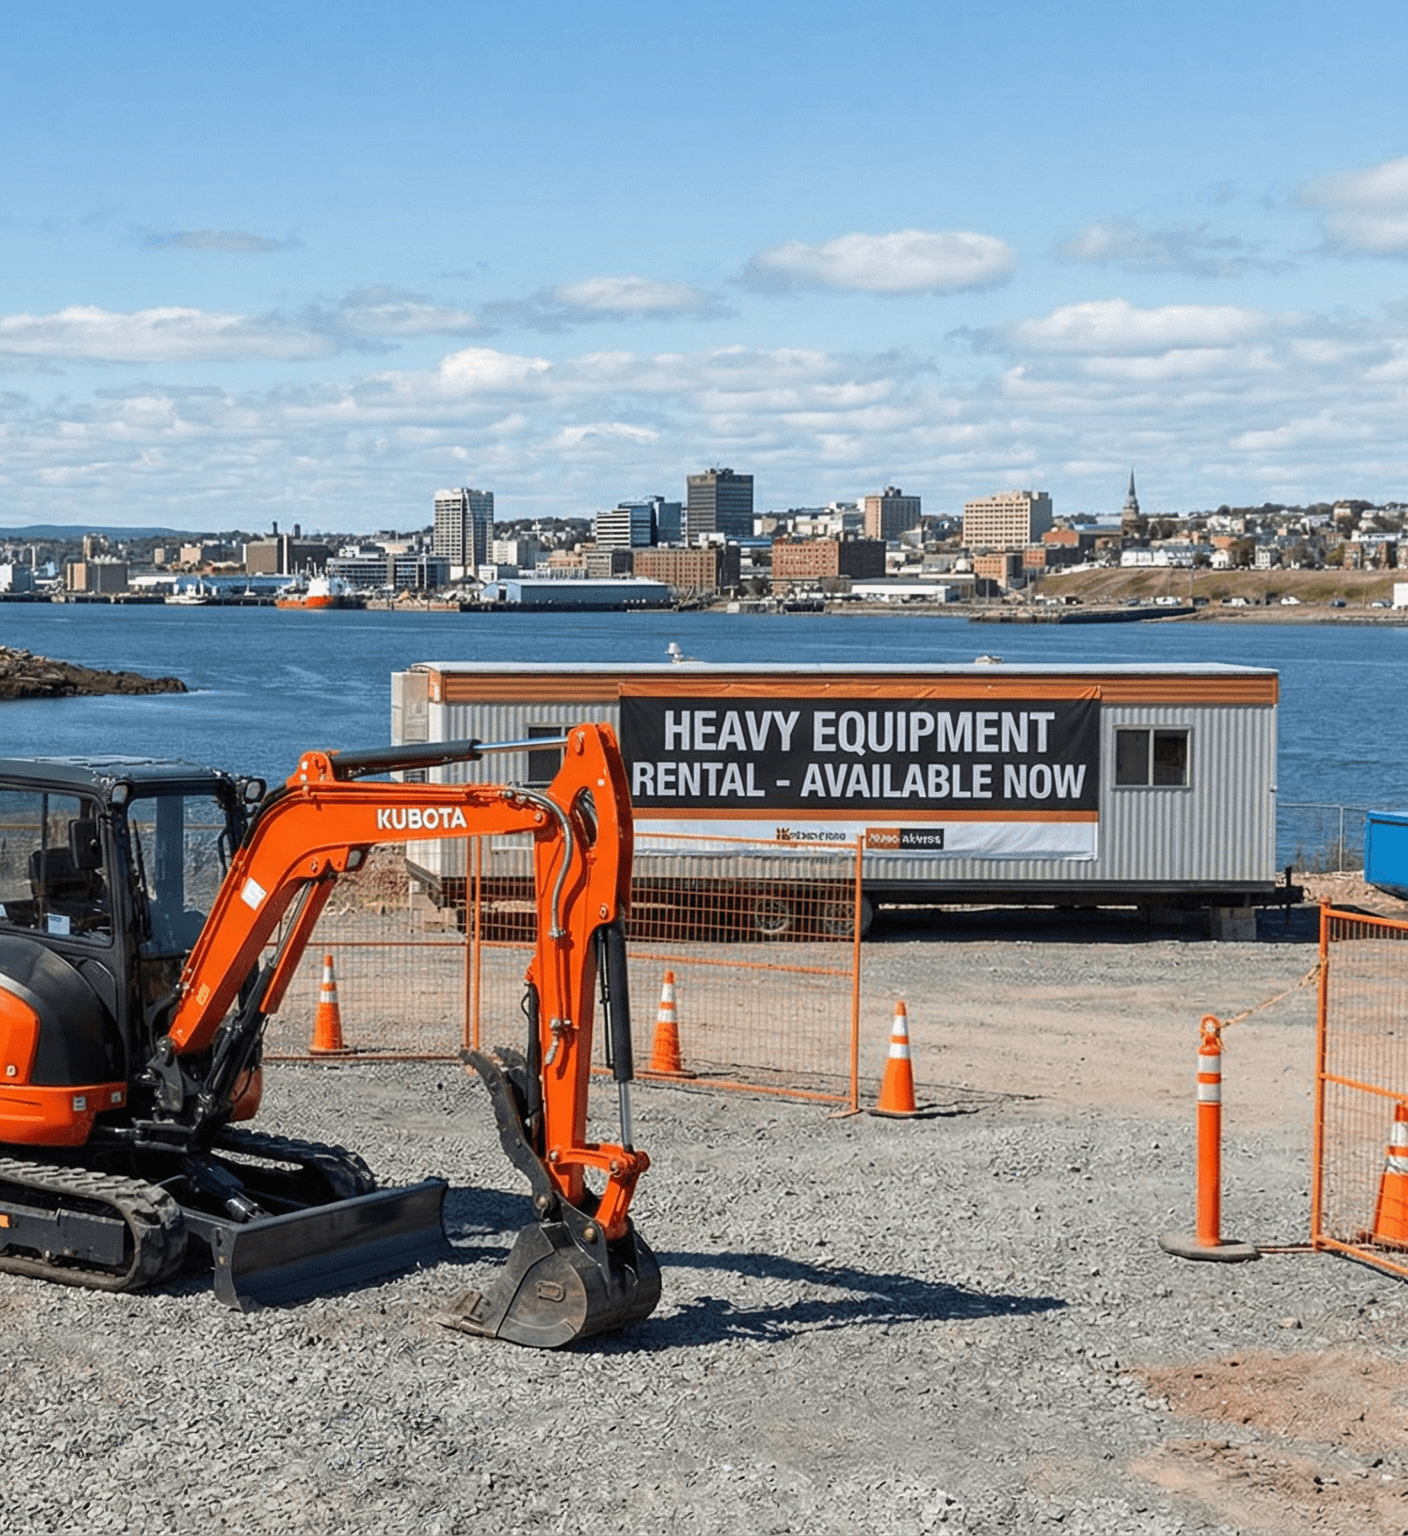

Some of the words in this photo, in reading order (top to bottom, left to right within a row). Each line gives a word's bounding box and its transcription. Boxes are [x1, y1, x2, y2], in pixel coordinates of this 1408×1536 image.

[664, 710, 800, 752] HEAVY
[813, 710, 1056, 757] EQUIPMENT
[632, 761, 766, 797] RENTAL
[800, 763, 993, 799] AVAILABLE
[1003, 763, 1087, 799] NOW
[377, 807, 467, 830] KUBOTA
